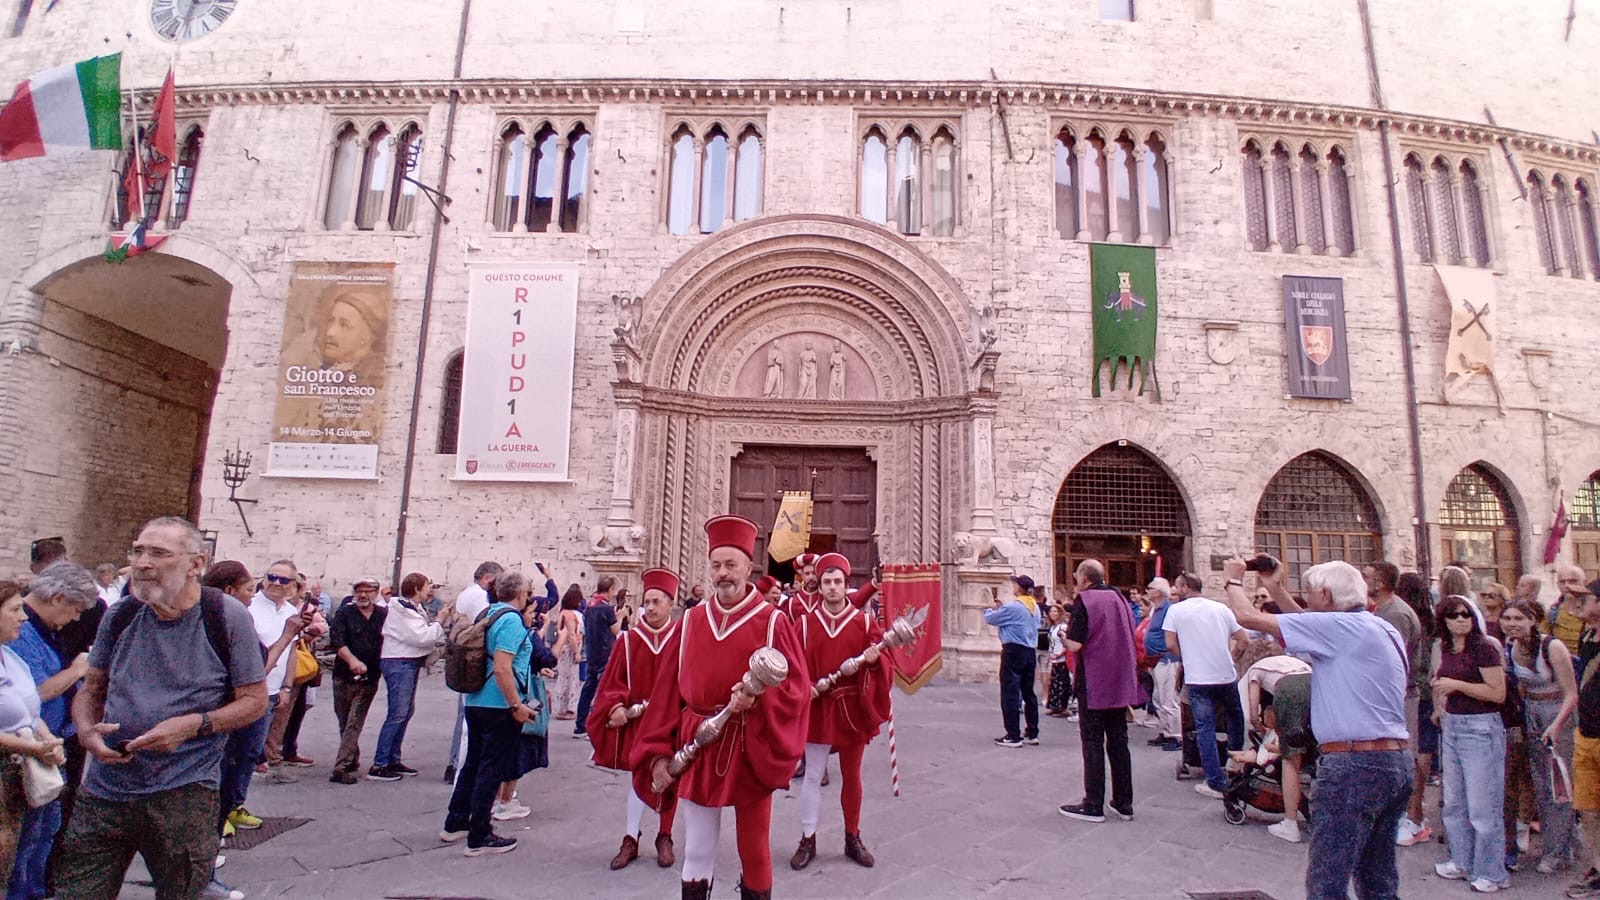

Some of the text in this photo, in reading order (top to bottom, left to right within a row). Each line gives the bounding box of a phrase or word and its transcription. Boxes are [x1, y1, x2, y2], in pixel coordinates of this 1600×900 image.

[485, 273, 520, 282] QUESTO
[286, 366, 357, 383] Giotto e
[283, 383, 376, 396] san Francesco
[280, 427, 289, 435] 14
[336, 428, 371, 439] Giugno
[487, 444, 539, 453] LA GUERRA
[517, 462, 557, 471] EMERGENCY
